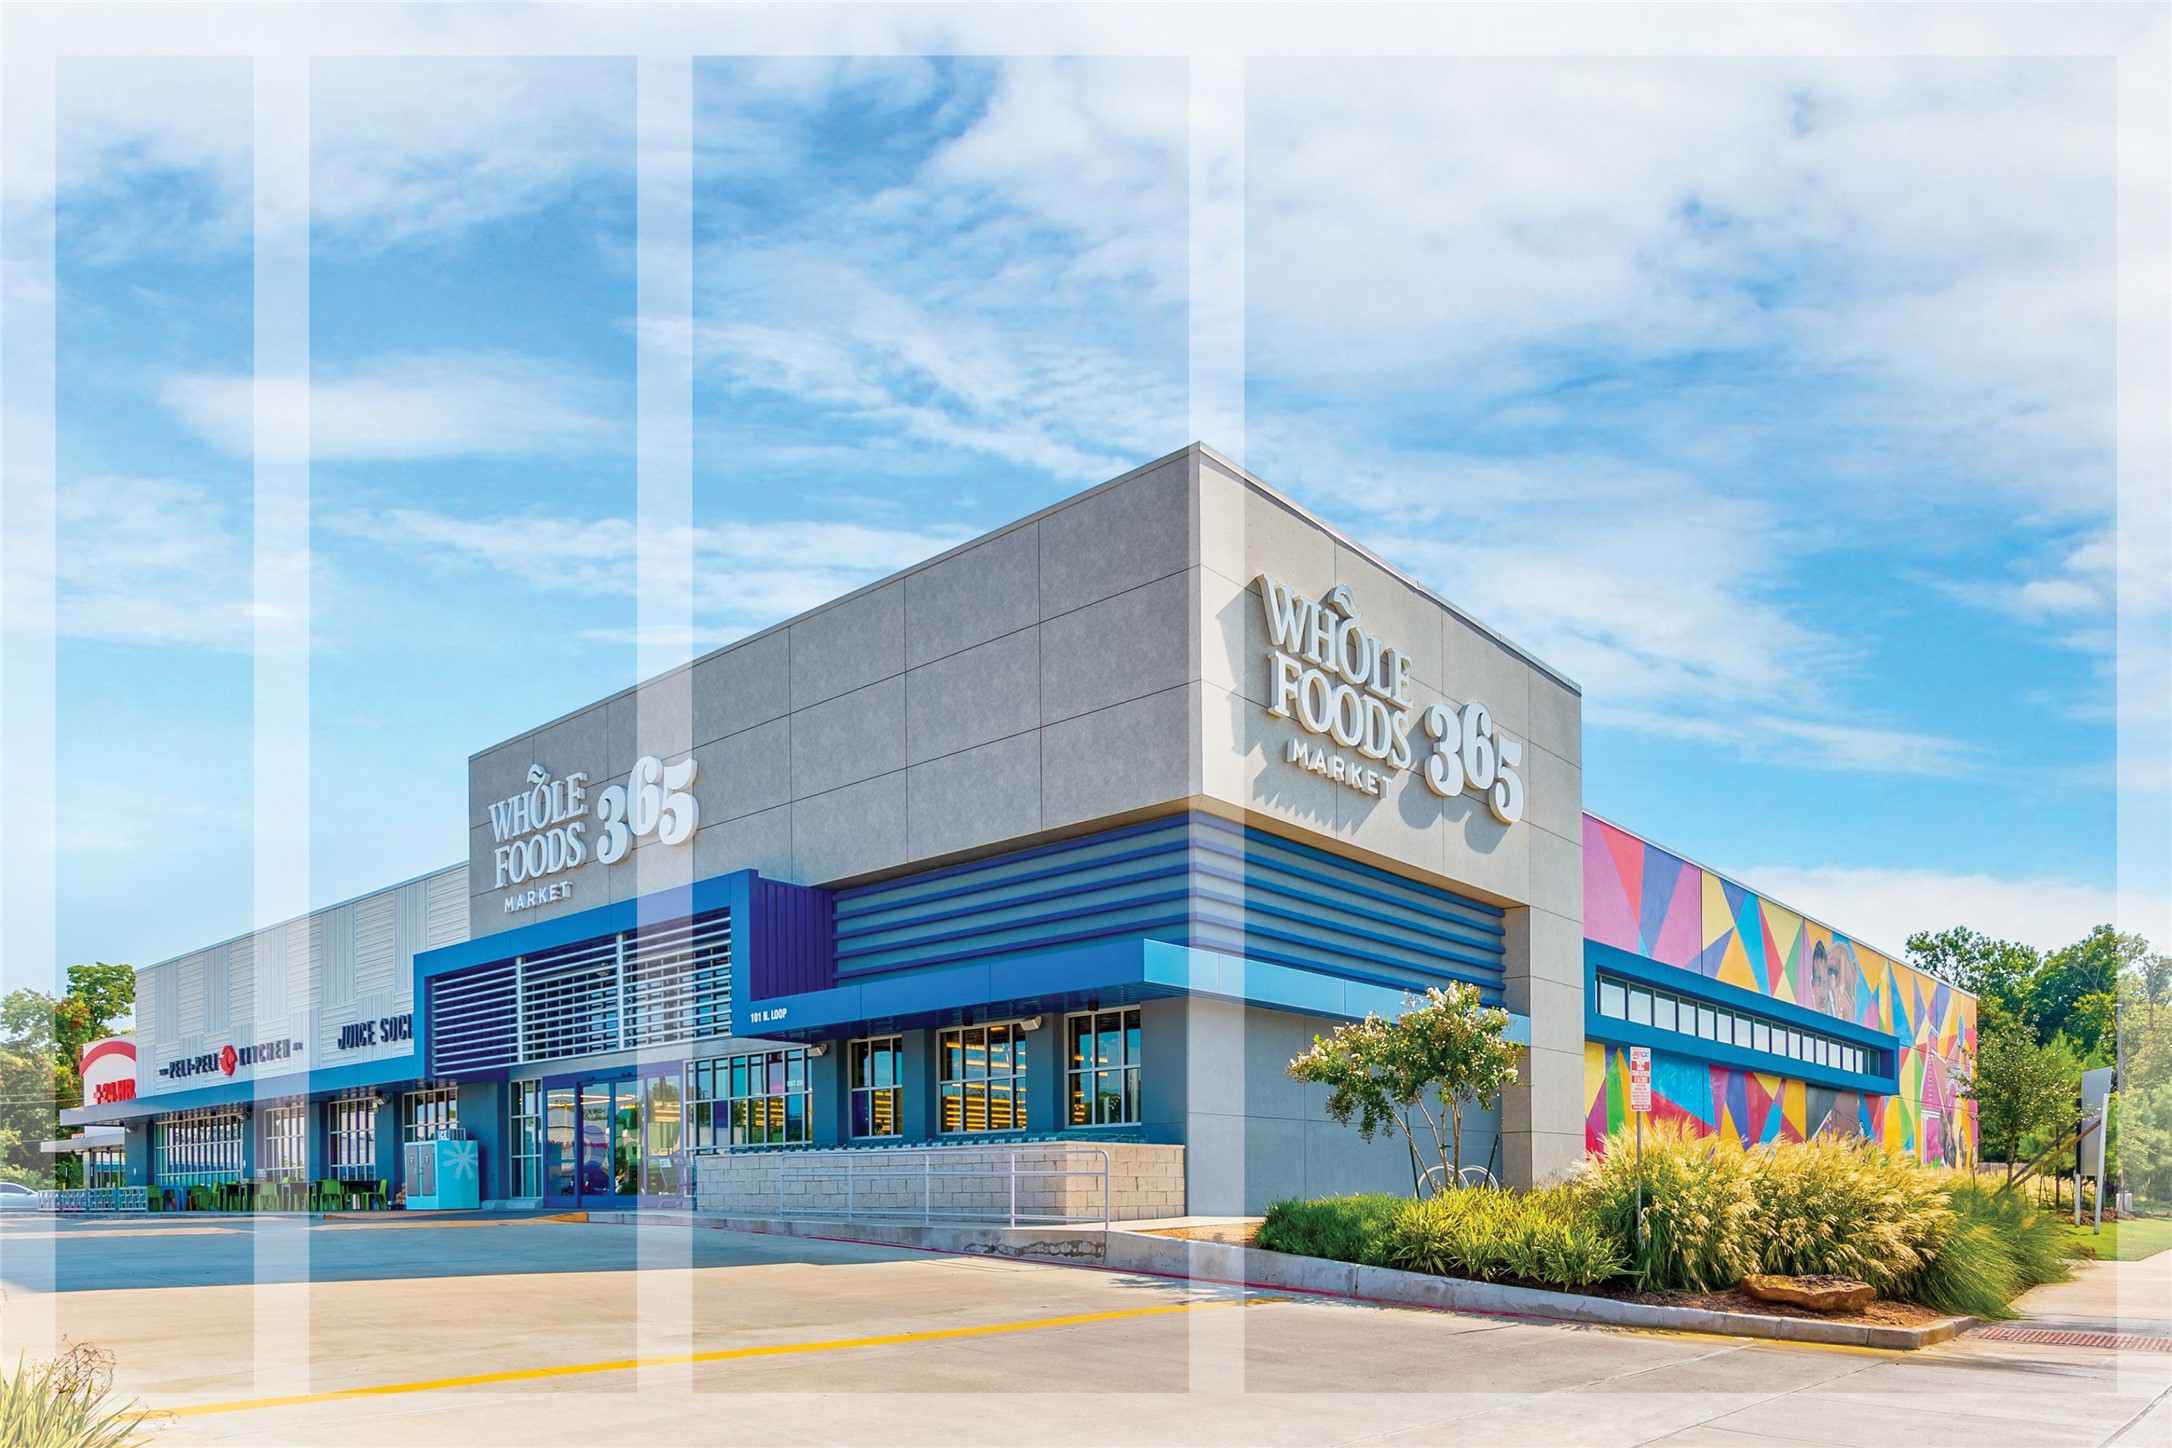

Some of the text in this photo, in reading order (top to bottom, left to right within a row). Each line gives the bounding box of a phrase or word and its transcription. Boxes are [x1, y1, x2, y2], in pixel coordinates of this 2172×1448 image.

[1256, 573, 1413, 711] WHOLE
[1268, 651, 1411, 769] FOODS
[1287, 738, 1392, 799] MARKET
[1424, 700, 1524, 823] 365
[488, 764, 590, 843] WHOLE
[597, 756, 699, 865] 365
[494, 821, 587, 889] FOODS
[504, 880, 573, 914] MARKET
[337, 1021, 376, 1050] JUICE
[750, 1012, 762, 1023] 101
[771, 1008, 787, 1020] LOOP
